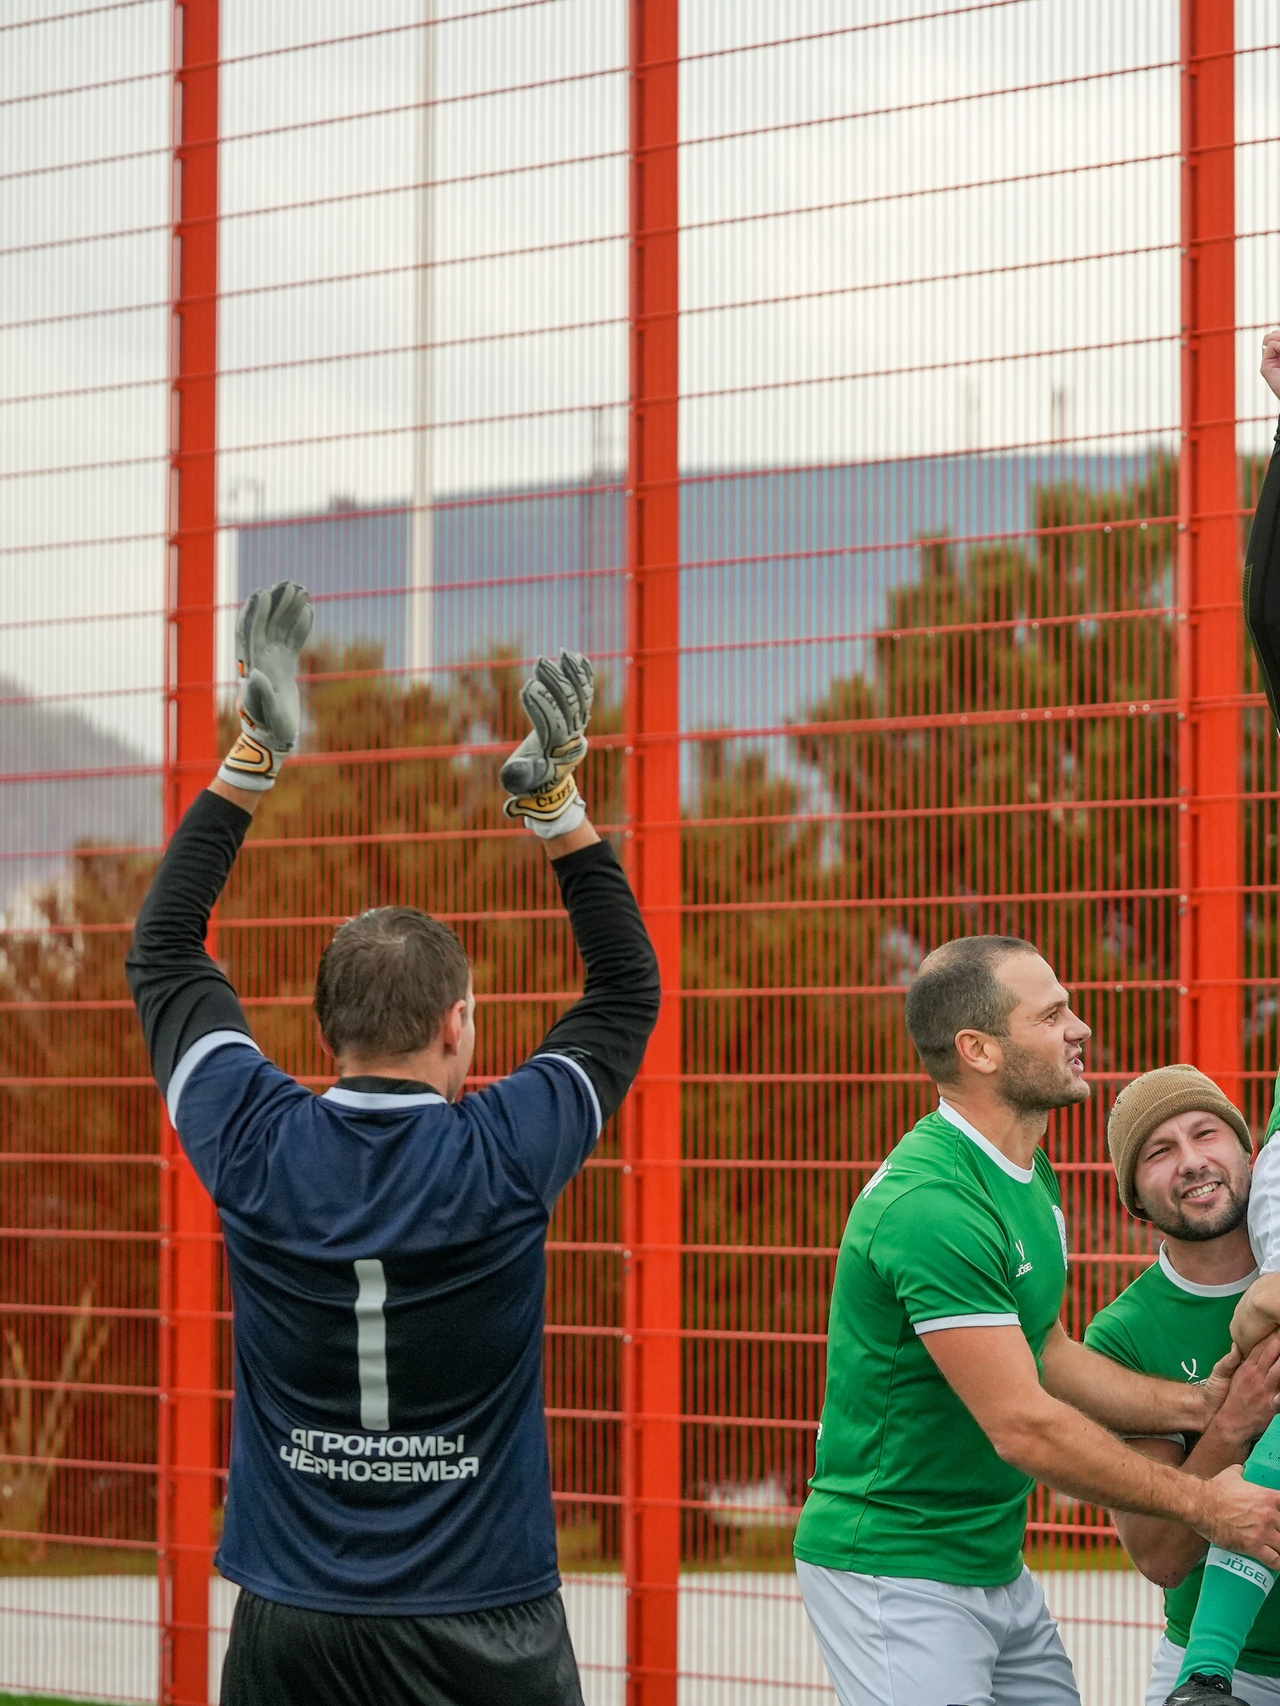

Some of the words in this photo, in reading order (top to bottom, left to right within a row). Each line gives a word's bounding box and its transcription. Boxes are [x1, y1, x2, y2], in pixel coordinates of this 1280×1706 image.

[353, 1259, 390, 1431] 1
[291, 1428, 465, 1458] АГРОНОМЫ
[279, 1445, 479, 1482] ЧЕРНОЗЕМЬЯ
[1219, 1557, 1267, 1588] JÖGEL
